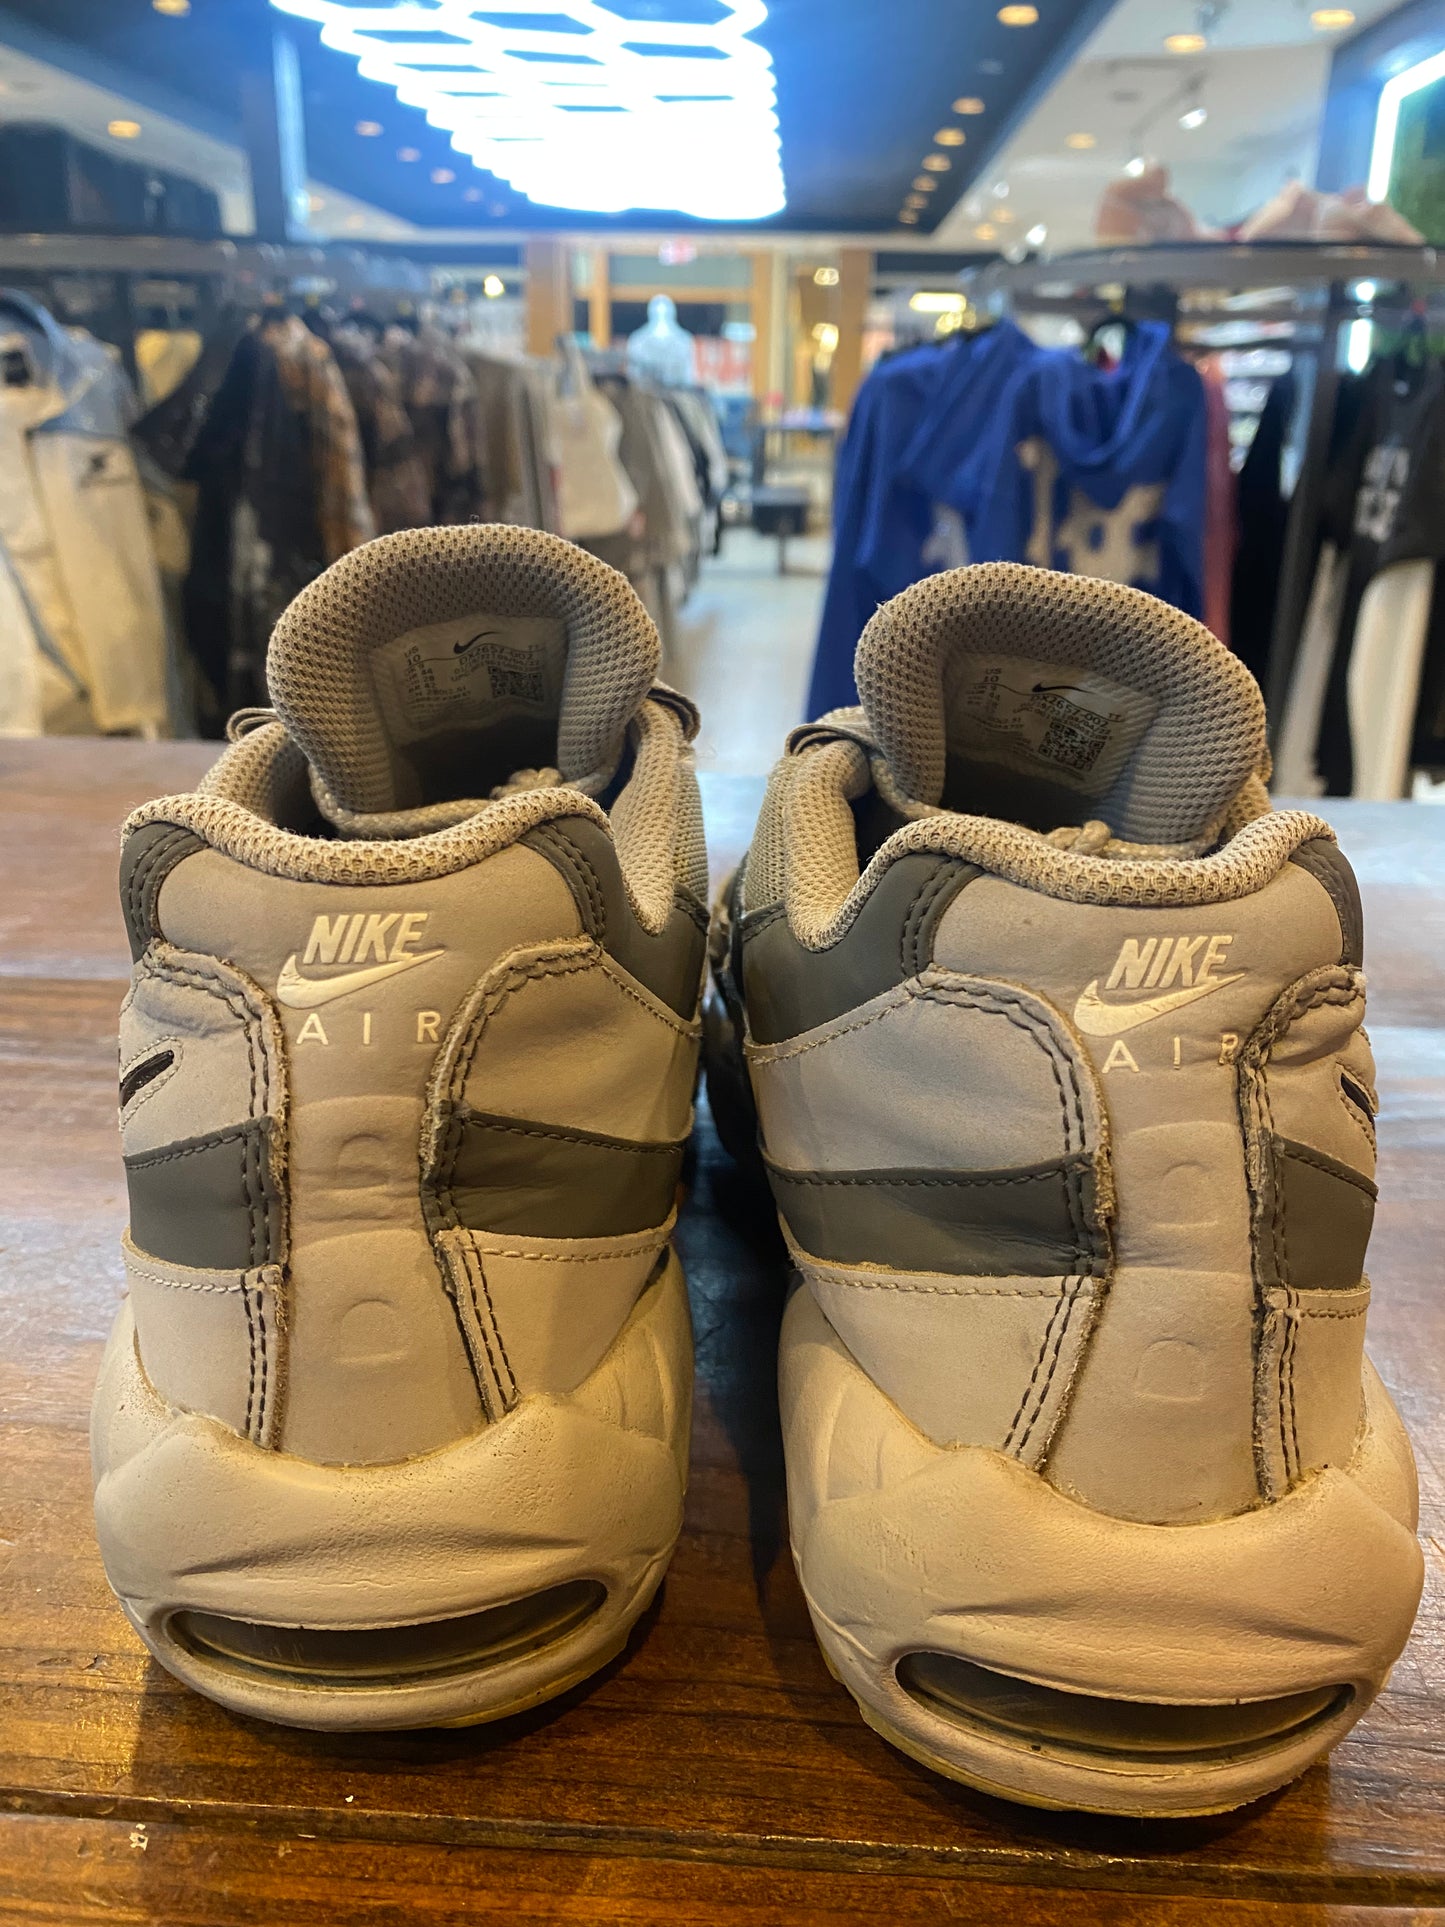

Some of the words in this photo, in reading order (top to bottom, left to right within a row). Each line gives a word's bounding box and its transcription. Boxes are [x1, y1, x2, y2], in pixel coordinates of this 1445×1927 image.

[404, 646, 419, 658] US
[408, 654, 421, 666] 10
[1031, 695, 1109, 728] DX2657-002
[303, 913, 428, 964] NIKE
[1105, 935, 1233, 990] NIKE
[296, 1011, 441, 1046] AIR
[1101, 1033, 1239, 1074] AIR
